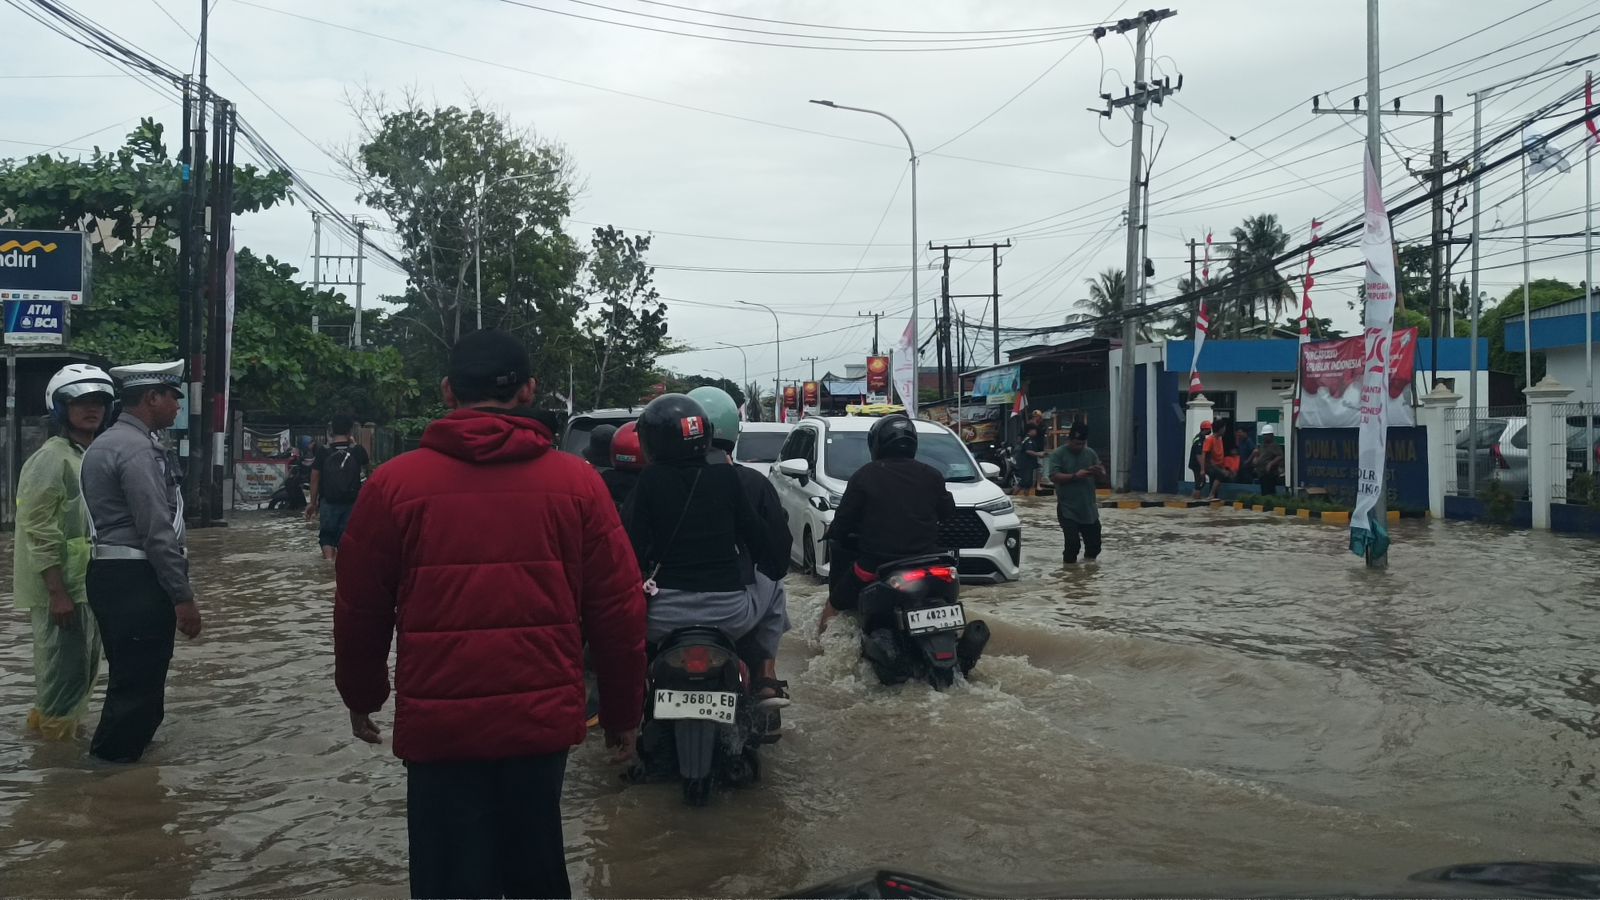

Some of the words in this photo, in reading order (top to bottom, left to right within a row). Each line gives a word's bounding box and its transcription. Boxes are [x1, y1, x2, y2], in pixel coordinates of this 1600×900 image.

[27, 304, 52, 315] ATM
[34, 317, 58, 328] BCA
[1305, 439, 1338, 459] DUMA
[910, 612, 920, 623] KT
[657, 692, 674, 703] KT
[682, 693, 713, 704] 3680
[720, 694, 735, 707] EB
